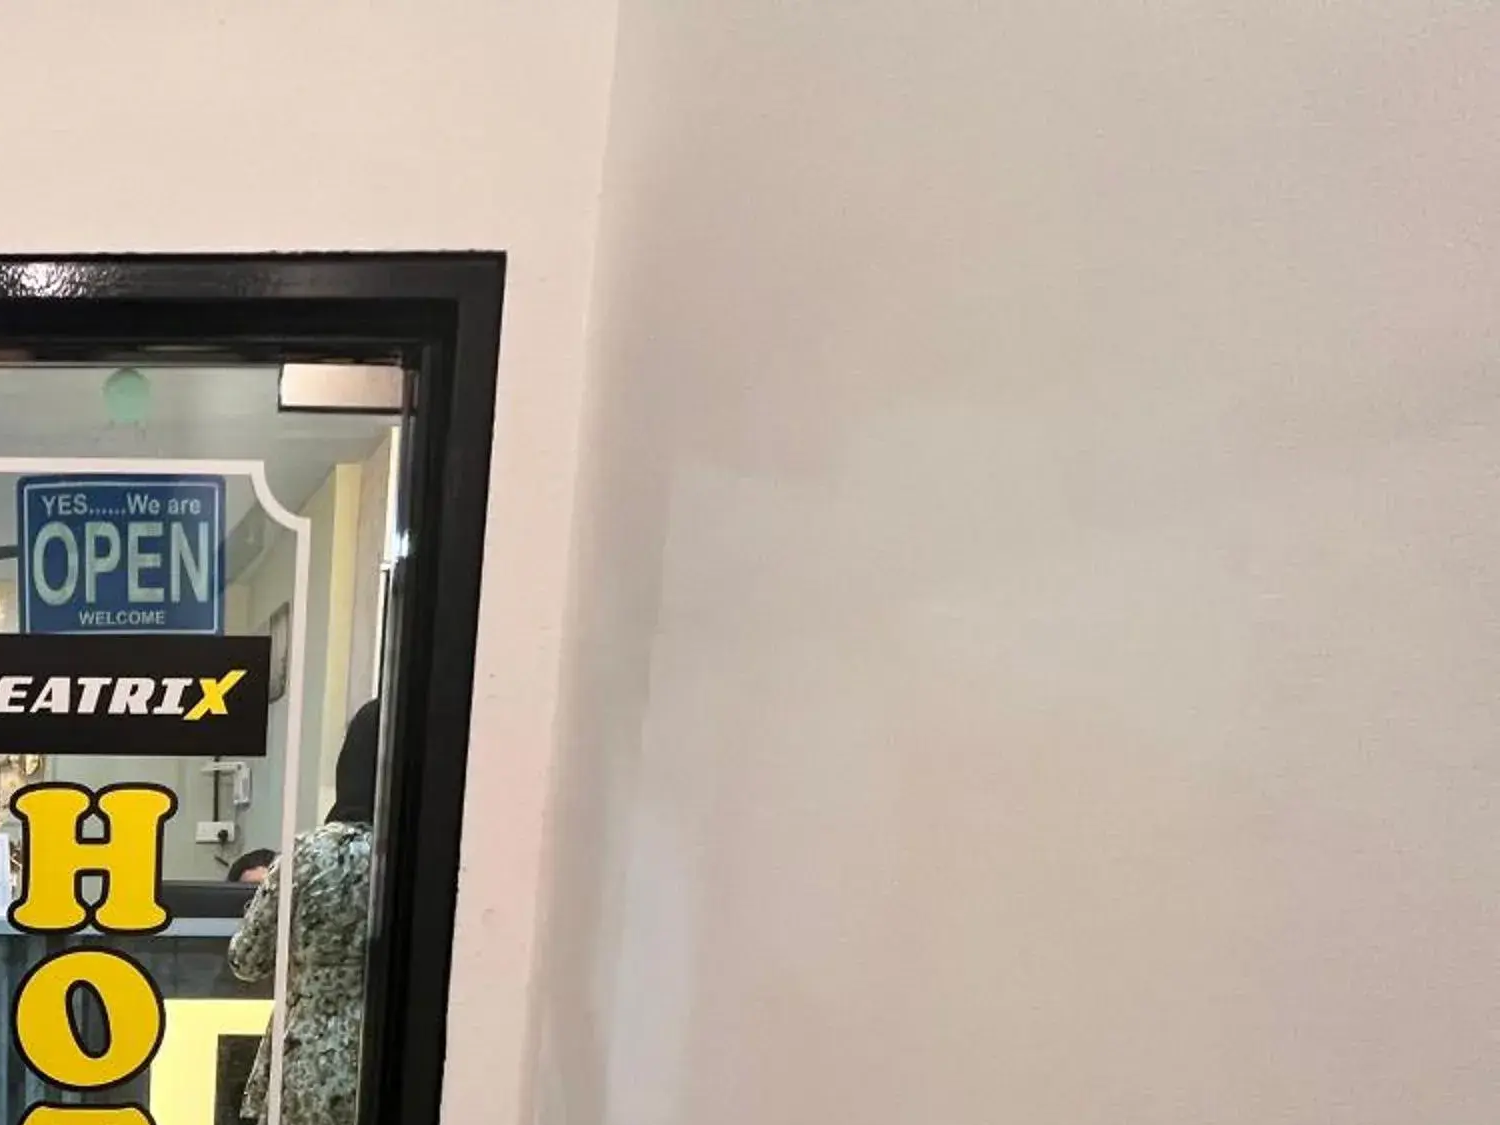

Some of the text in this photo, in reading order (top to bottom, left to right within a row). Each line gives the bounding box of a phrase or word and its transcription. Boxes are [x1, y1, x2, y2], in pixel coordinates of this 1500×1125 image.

[168, 498, 201, 515] are
[33, 521, 209, 605] OPEN
[78, 610, 166, 625] WELCOME
